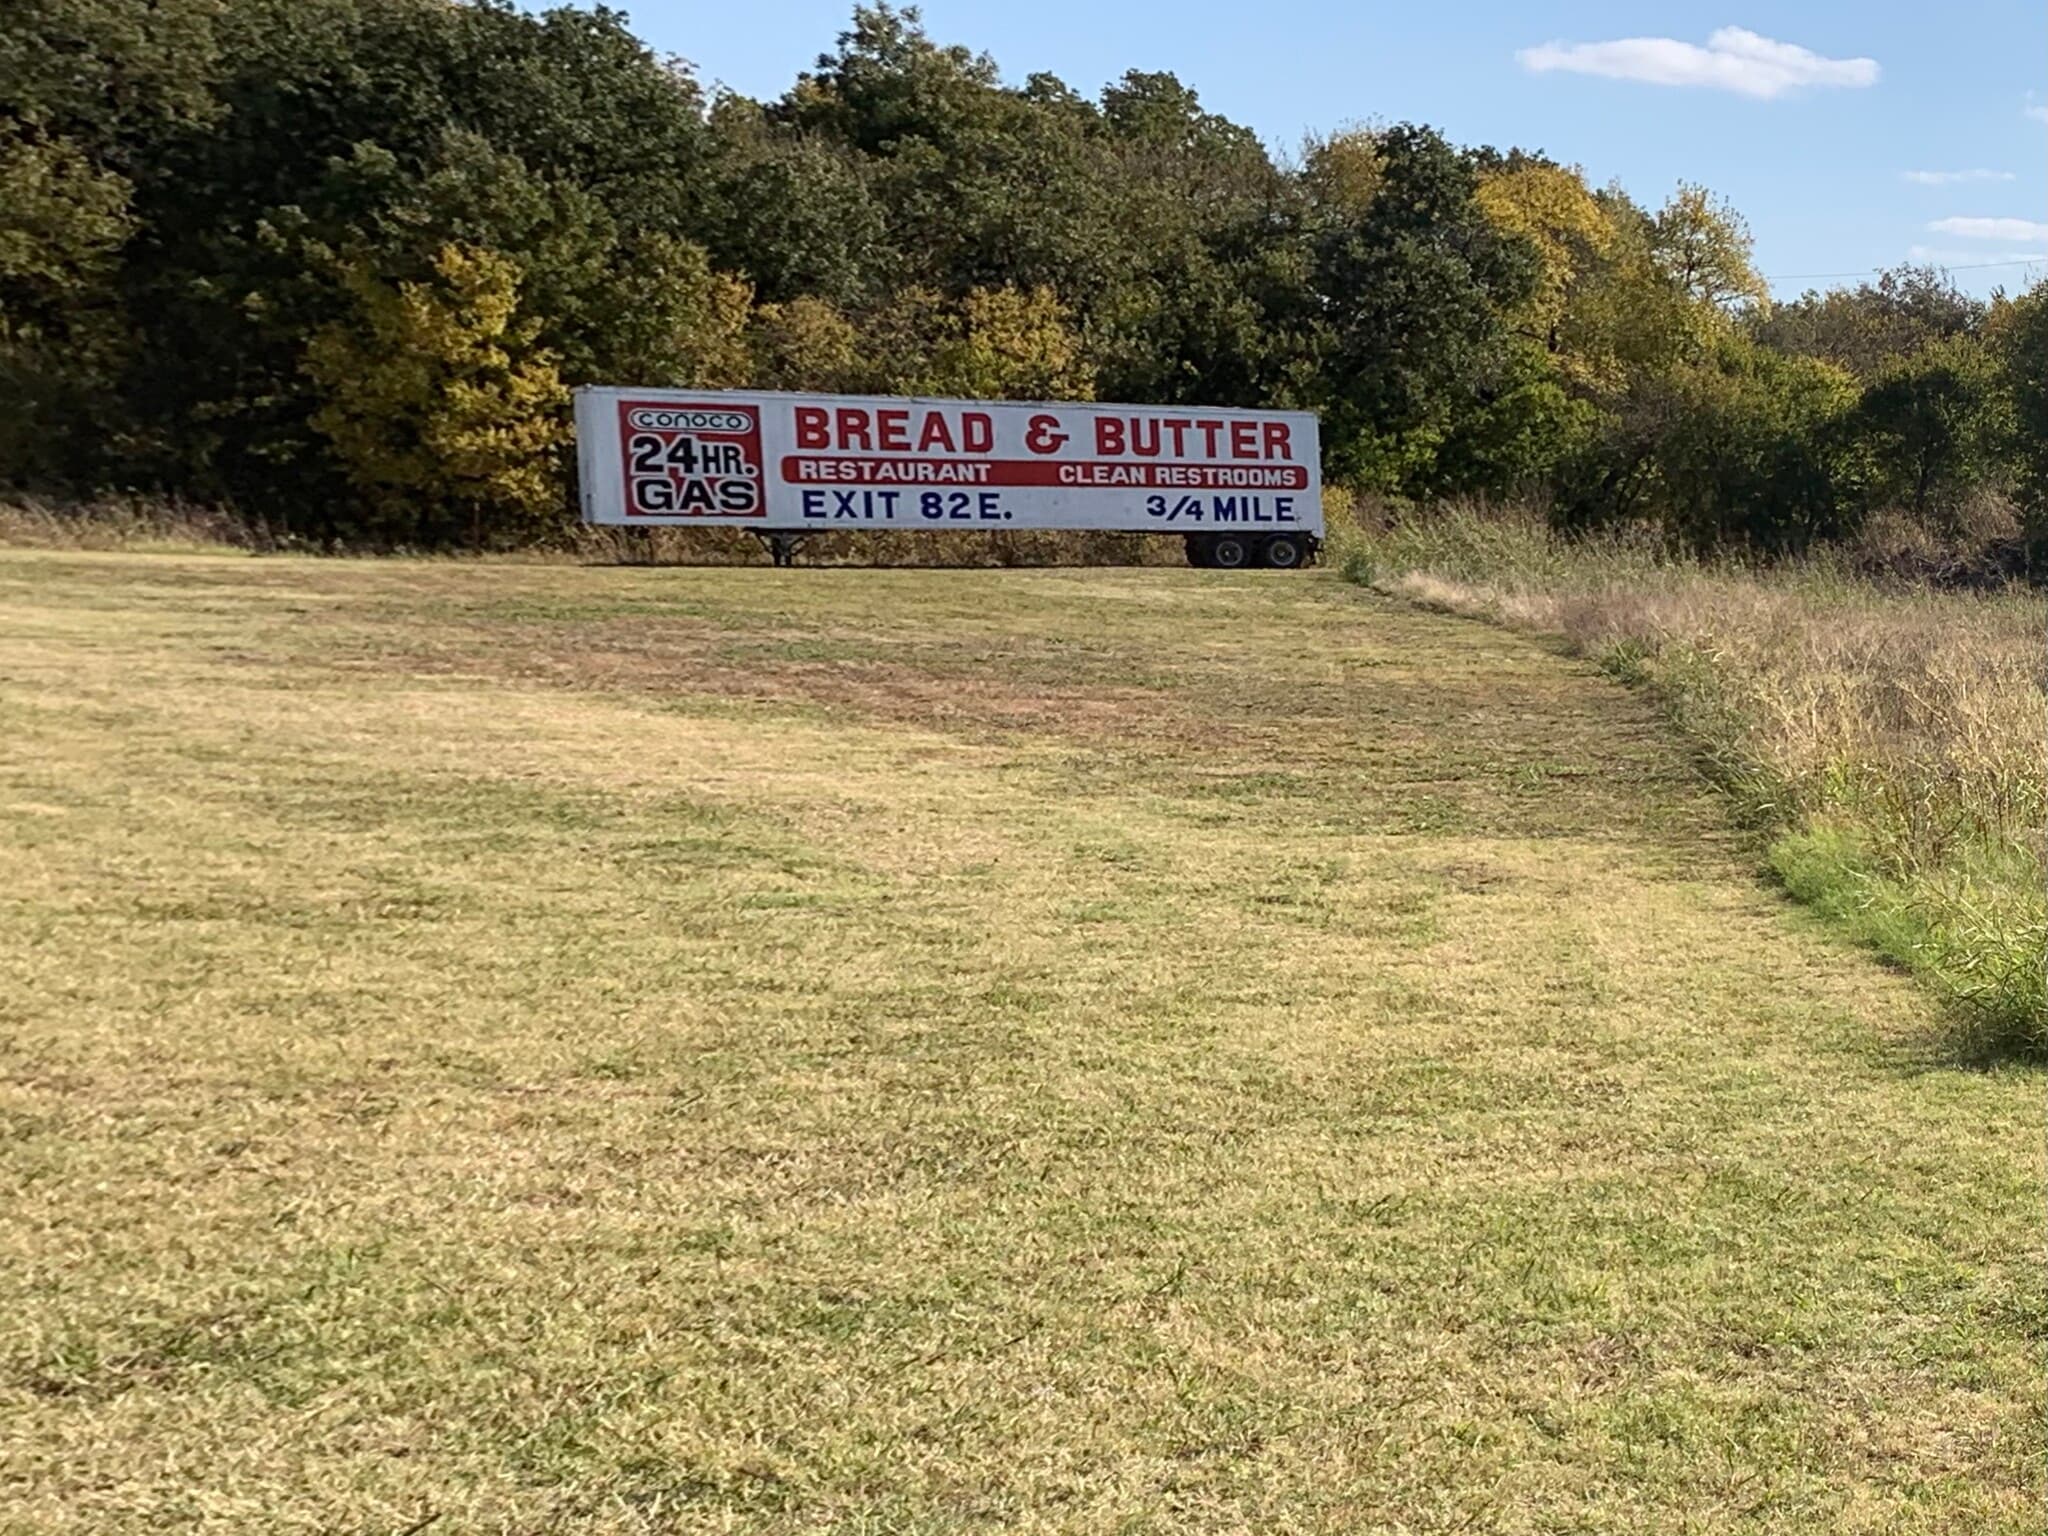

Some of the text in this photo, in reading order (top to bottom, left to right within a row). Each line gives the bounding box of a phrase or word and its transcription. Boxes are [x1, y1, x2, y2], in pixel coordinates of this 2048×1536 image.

[639, 413, 742, 429] conoco
[795, 407, 1293, 460] BREAD & BUTTER
[799, 460, 991, 482] RESTAURANT
[1059, 465, 1297, 486] CLEAN RESTROOMS
[637, 479, 755, 511] GAS
[802, 490, 900, 519] EXIT
[1147, 495, 1204, 521] 3/4
